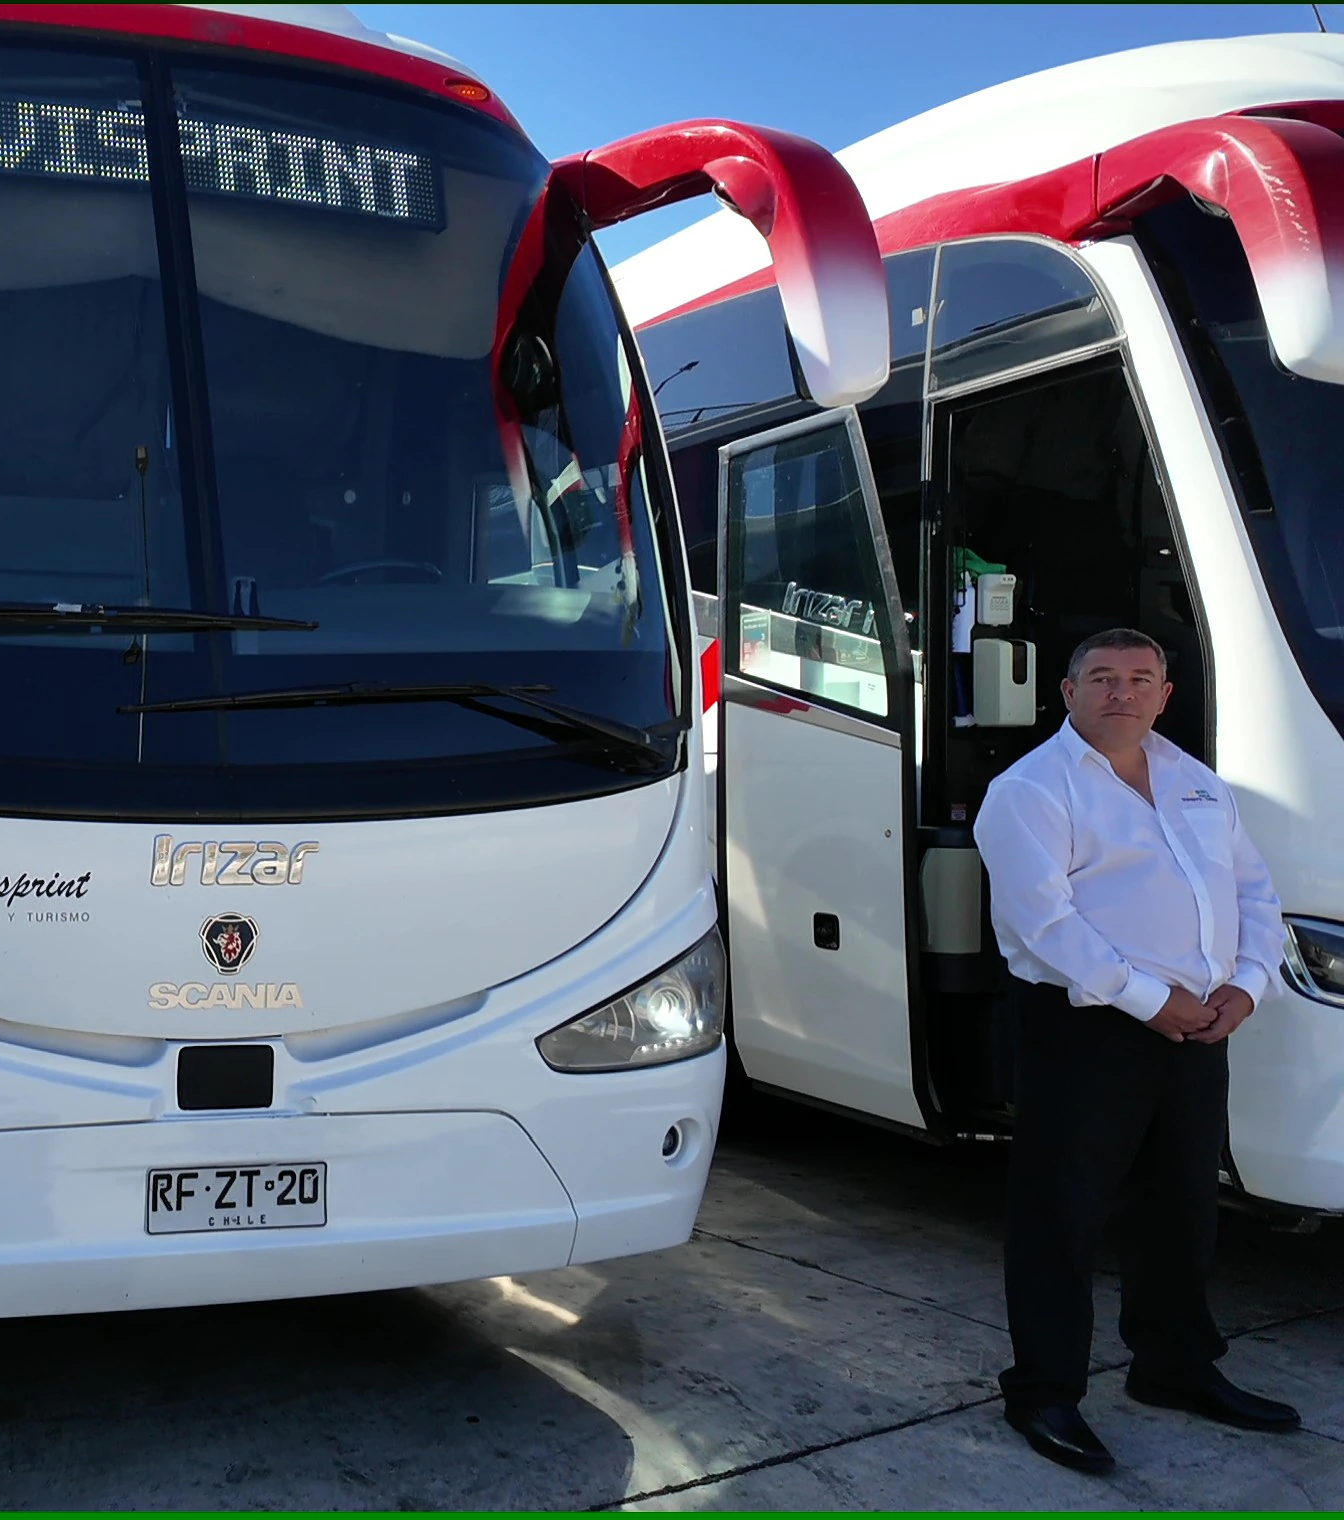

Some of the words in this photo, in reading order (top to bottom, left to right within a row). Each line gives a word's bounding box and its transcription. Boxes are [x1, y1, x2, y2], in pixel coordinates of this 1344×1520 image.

[782, 581, 863, 628] Irizar
[150, 833, 321, 886] Irizar
[8, 912, 15, 922] Y
[26, 911, 91, 923] TURISMO
[147, 981, 304, 1011] SCANIA
[208, 1214, 267, 1227] CHILE
